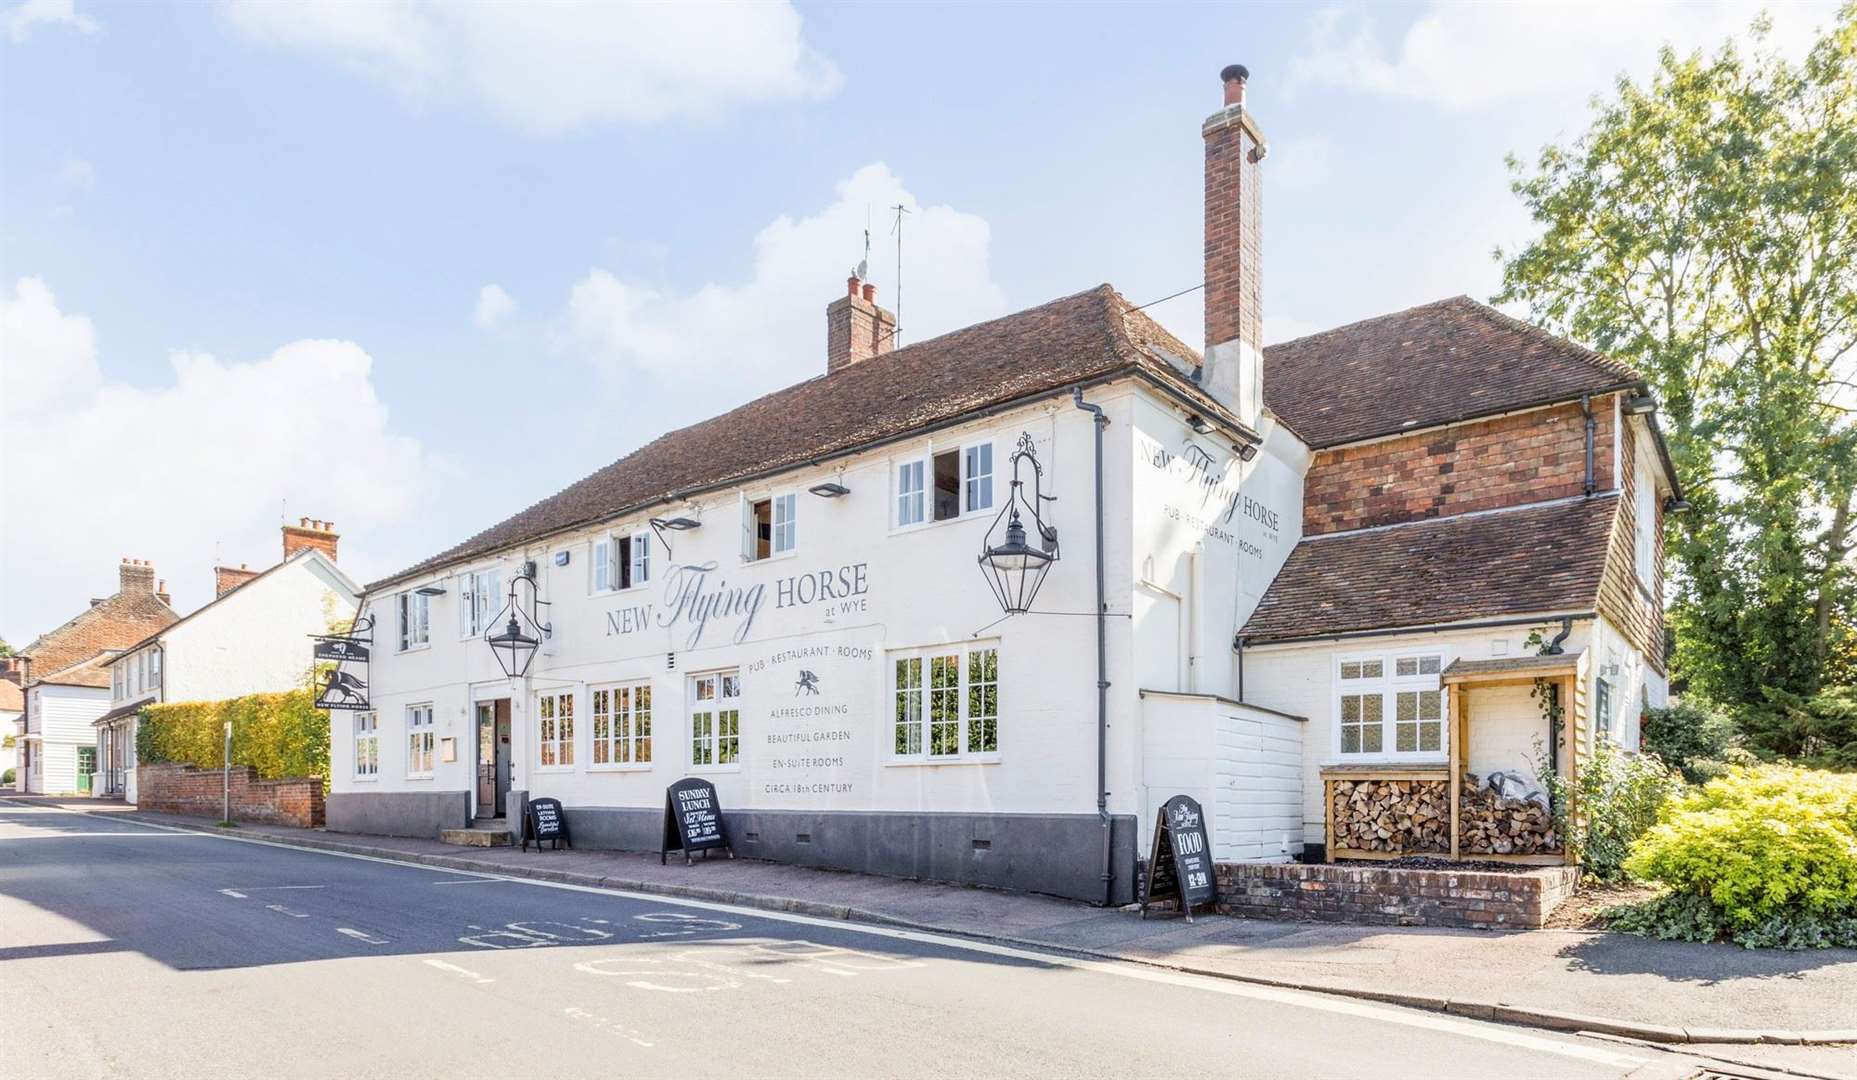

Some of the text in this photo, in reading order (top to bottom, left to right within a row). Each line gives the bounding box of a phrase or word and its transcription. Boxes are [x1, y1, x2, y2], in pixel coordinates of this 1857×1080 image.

[1140, 438, 1279, 532] NEW Flying HORSE
[1164, 504, 1263, 560] PUB RESTAURANT ROOMS
[606, 561, 870, 650] NEW Flying HORSE
[841, 599, 867, 615] WYE
[749, 646, 873, 672] PUB RESTAURANT ROOMS
[771, 705, 848, 719] ALFRESCO DINING
[767, 731, 851, 744] BEAUTIFUL GARDEN
[772, 757, 844, 769] EN-SUITE ROOMS
[678, 788, 710, 801] SUNDAY
[764, 783, 853, 794] CIRCA 18th CENTURY
[682, 799, 711, 812] LUNCH
[1177, 831, 1202, 856] FOOD
